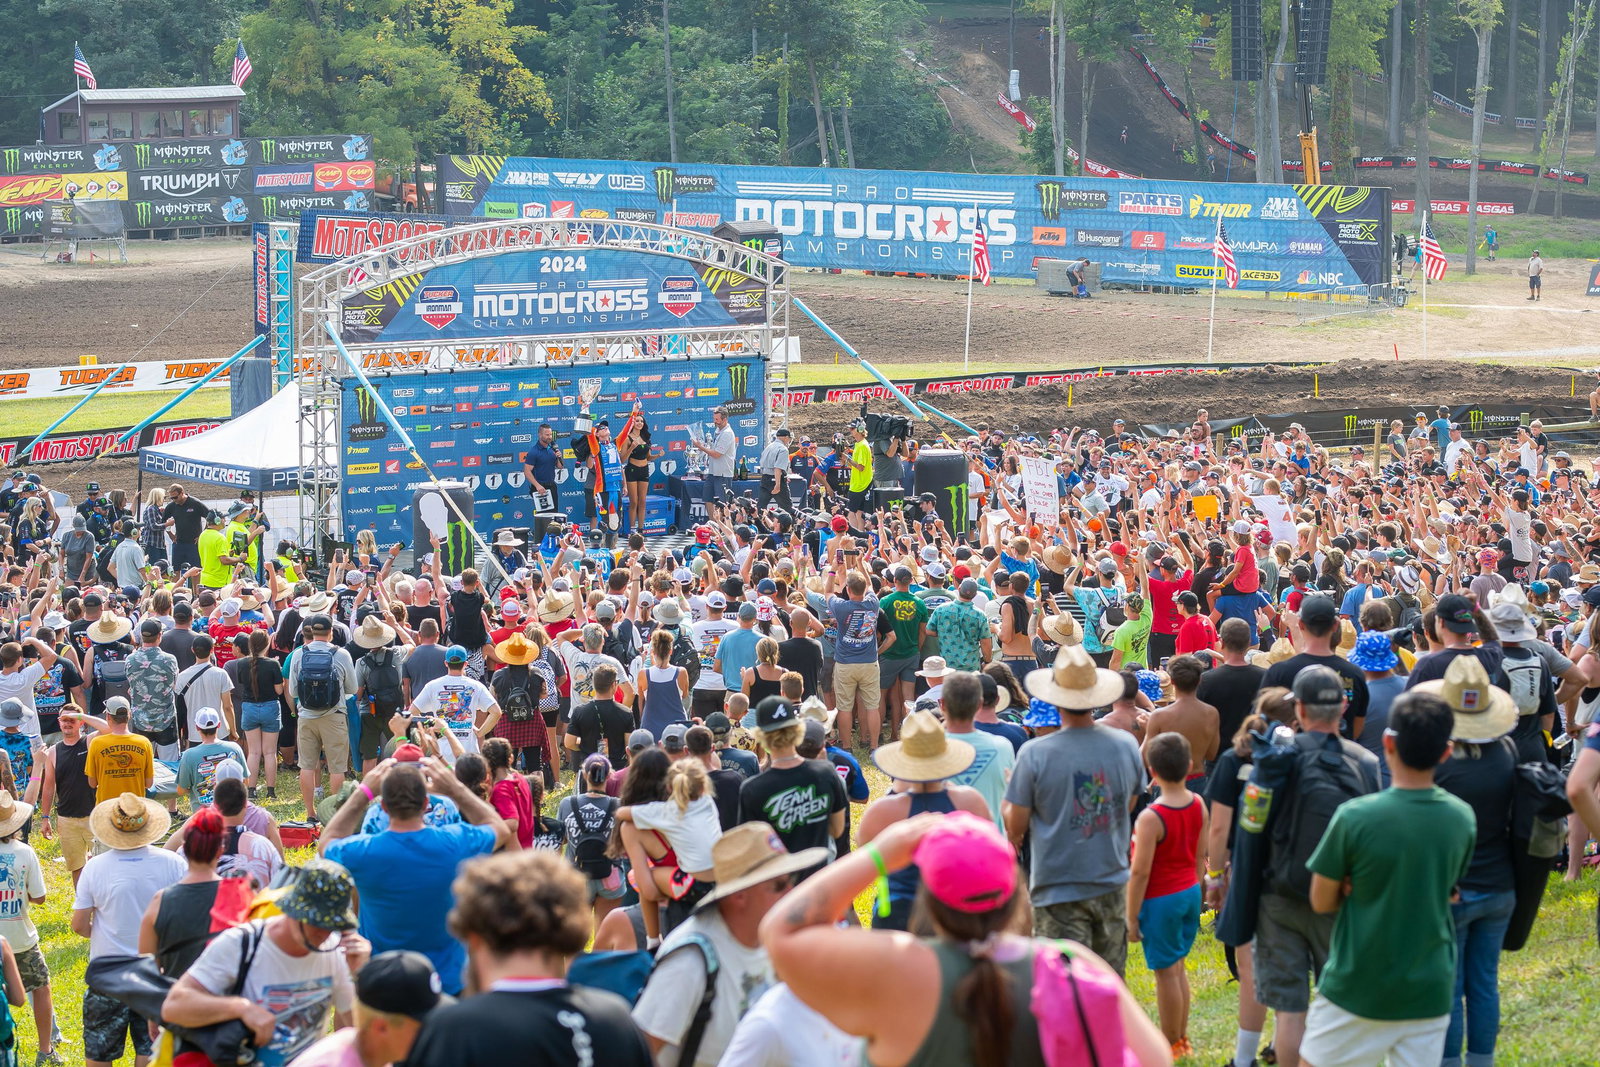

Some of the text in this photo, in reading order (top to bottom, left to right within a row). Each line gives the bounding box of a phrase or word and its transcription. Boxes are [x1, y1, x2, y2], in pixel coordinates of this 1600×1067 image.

[154, 145, 212, 157] MONSTER
[279, 140, 334, 152] MONSTER
[24, 150, 84, 162] MONSTER
[140, 172, 220, 194] TRIUMPH
[504, 171, 549, 185] AMA PRO
[565, 172, 604, 184] FLY
[608, 174, 645, 191] WPS
[675, 177, 714, 186] MONSTER
[0, 177, 62, 202] FMF
[1061, 190, 1107, 201] MONSTER
[280, 197, 335, 210] MONSTER
[1120, 192, 1182, 206] PARTS
[1262, 197, 1298, 210] AMA
[155, 202, 213, 215] MONSTER
[488, 206, 515, 215] Kawasaki
[525, 207, 544, 217] 100%
[1120, 204, 1182, 215] UNLIMITED
[1281, 210, 1298, 218] YEARS
[616, 211, 648, 221] TRIUMPH
[736, 198, 1016, 245] MOTOCROSS
[1040, 232, 1060, 241] KTM
[1086, 233, 1120, 243] Husqvarna
[782, 239, 1014, 262] AMPIONSHP
[1295, 242, 1322, 251] YAMAHA
[540, 256, 587, 273] 2024
[1179, 267, 1222, 277] SUZUKI
[1241, 271, 1280, 280] ACERBIS
[1318, 272, 1344, 285] NBC
[540, 281, 586, 290] PRO
[473, 289, 648, 318] MOTOCROSS
[473, 312, 649, 328] CHAMPIONSHIP
[60, 366, 138, 386] TUCKER
[393, 388, 414, 397] WPS
[740, 419, 758, 427] WPS
[511, 434, 531, 443] WPS
[1026, 459, 1050, 477] FBI
[375, 484, 398, 493] peacock
[100, 745, 145, 757] FASTHOUSE
[764, 786, 813, 817] TEAM
[779, 796, 828, 829] GREEN
